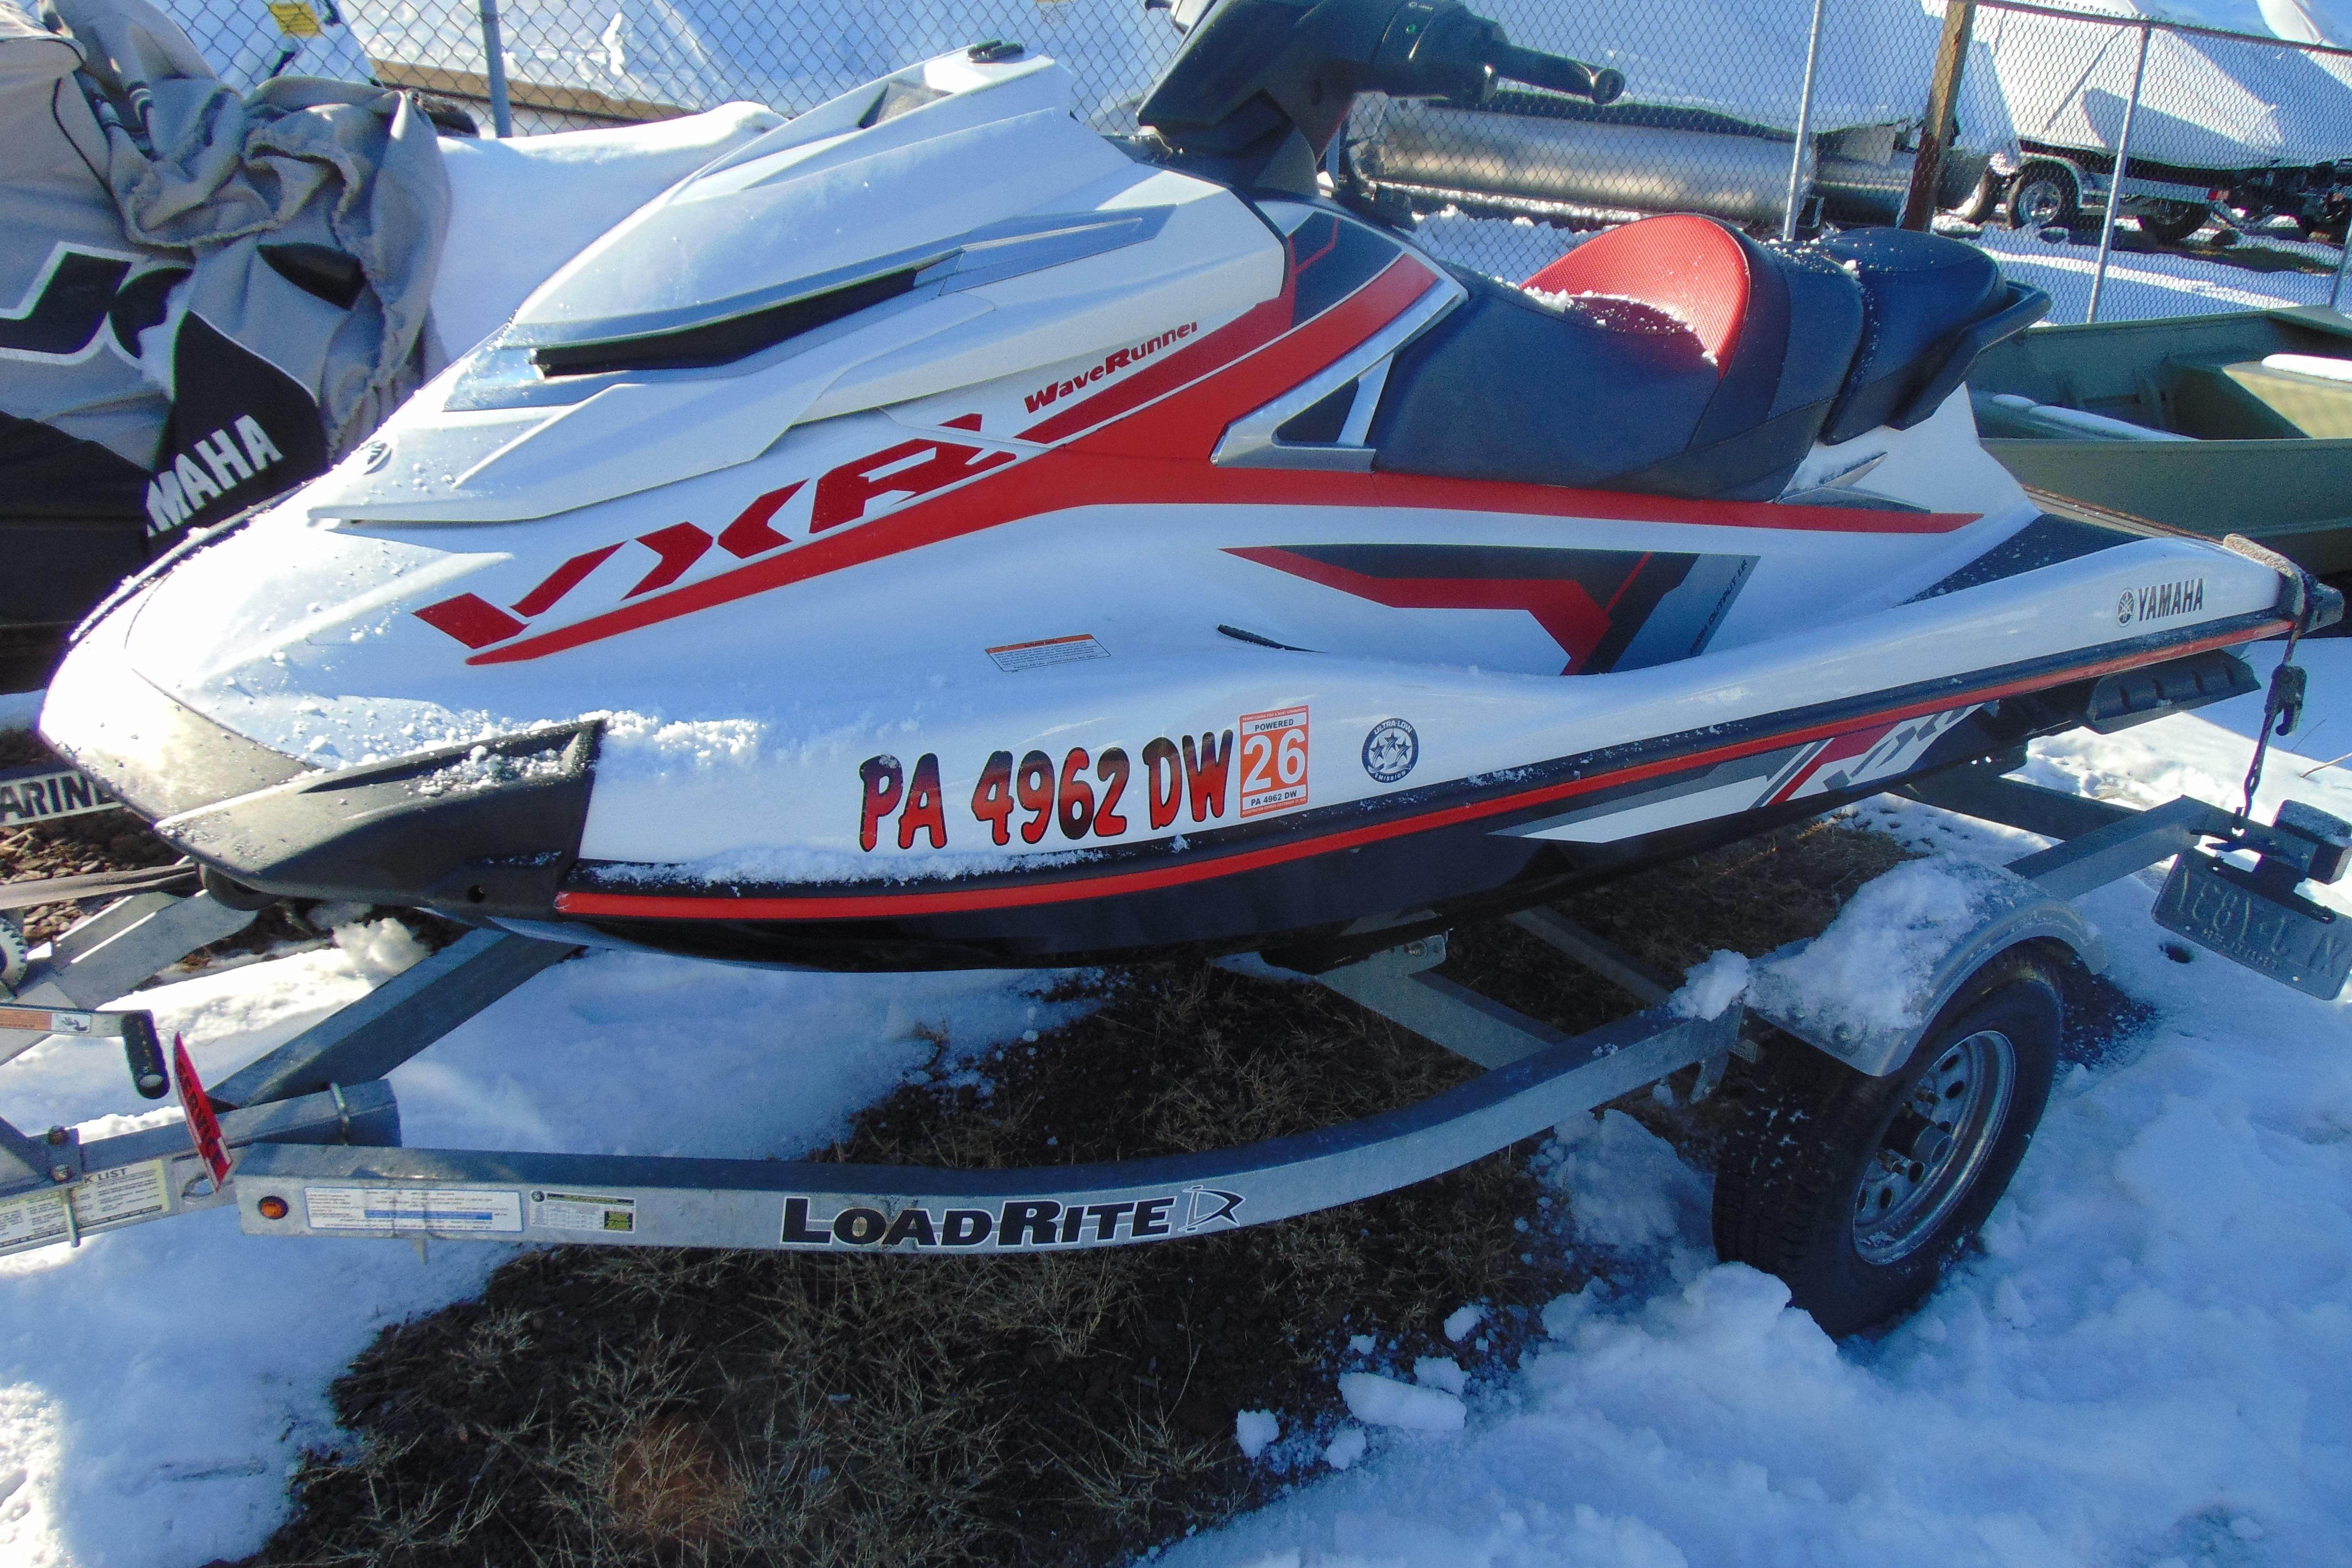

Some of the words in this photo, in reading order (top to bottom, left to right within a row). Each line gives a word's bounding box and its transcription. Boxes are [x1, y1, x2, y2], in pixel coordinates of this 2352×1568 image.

[1024, 321, 1197, 414] WaveRunner
[147, 414, 284, 538] MAHA
[2138, 578, 2204, 621] YAMAHA
[1255, 718, 1294, 732] POWERED
[1242, 729, 1306, 793] 26
[1375, 770, 1406, 781] EMISSION
[859, 753, 947, 852] PA
[971, 747, 1130, 846] 4962
[1142, 729, 1234, 830] DW
[1251, 798, 1261, 806] PA
[1263, 793, 1282, 803] 4962
[1284, 790, 1297, 799] DW
[98, 1168, 129, 1181] LIST
